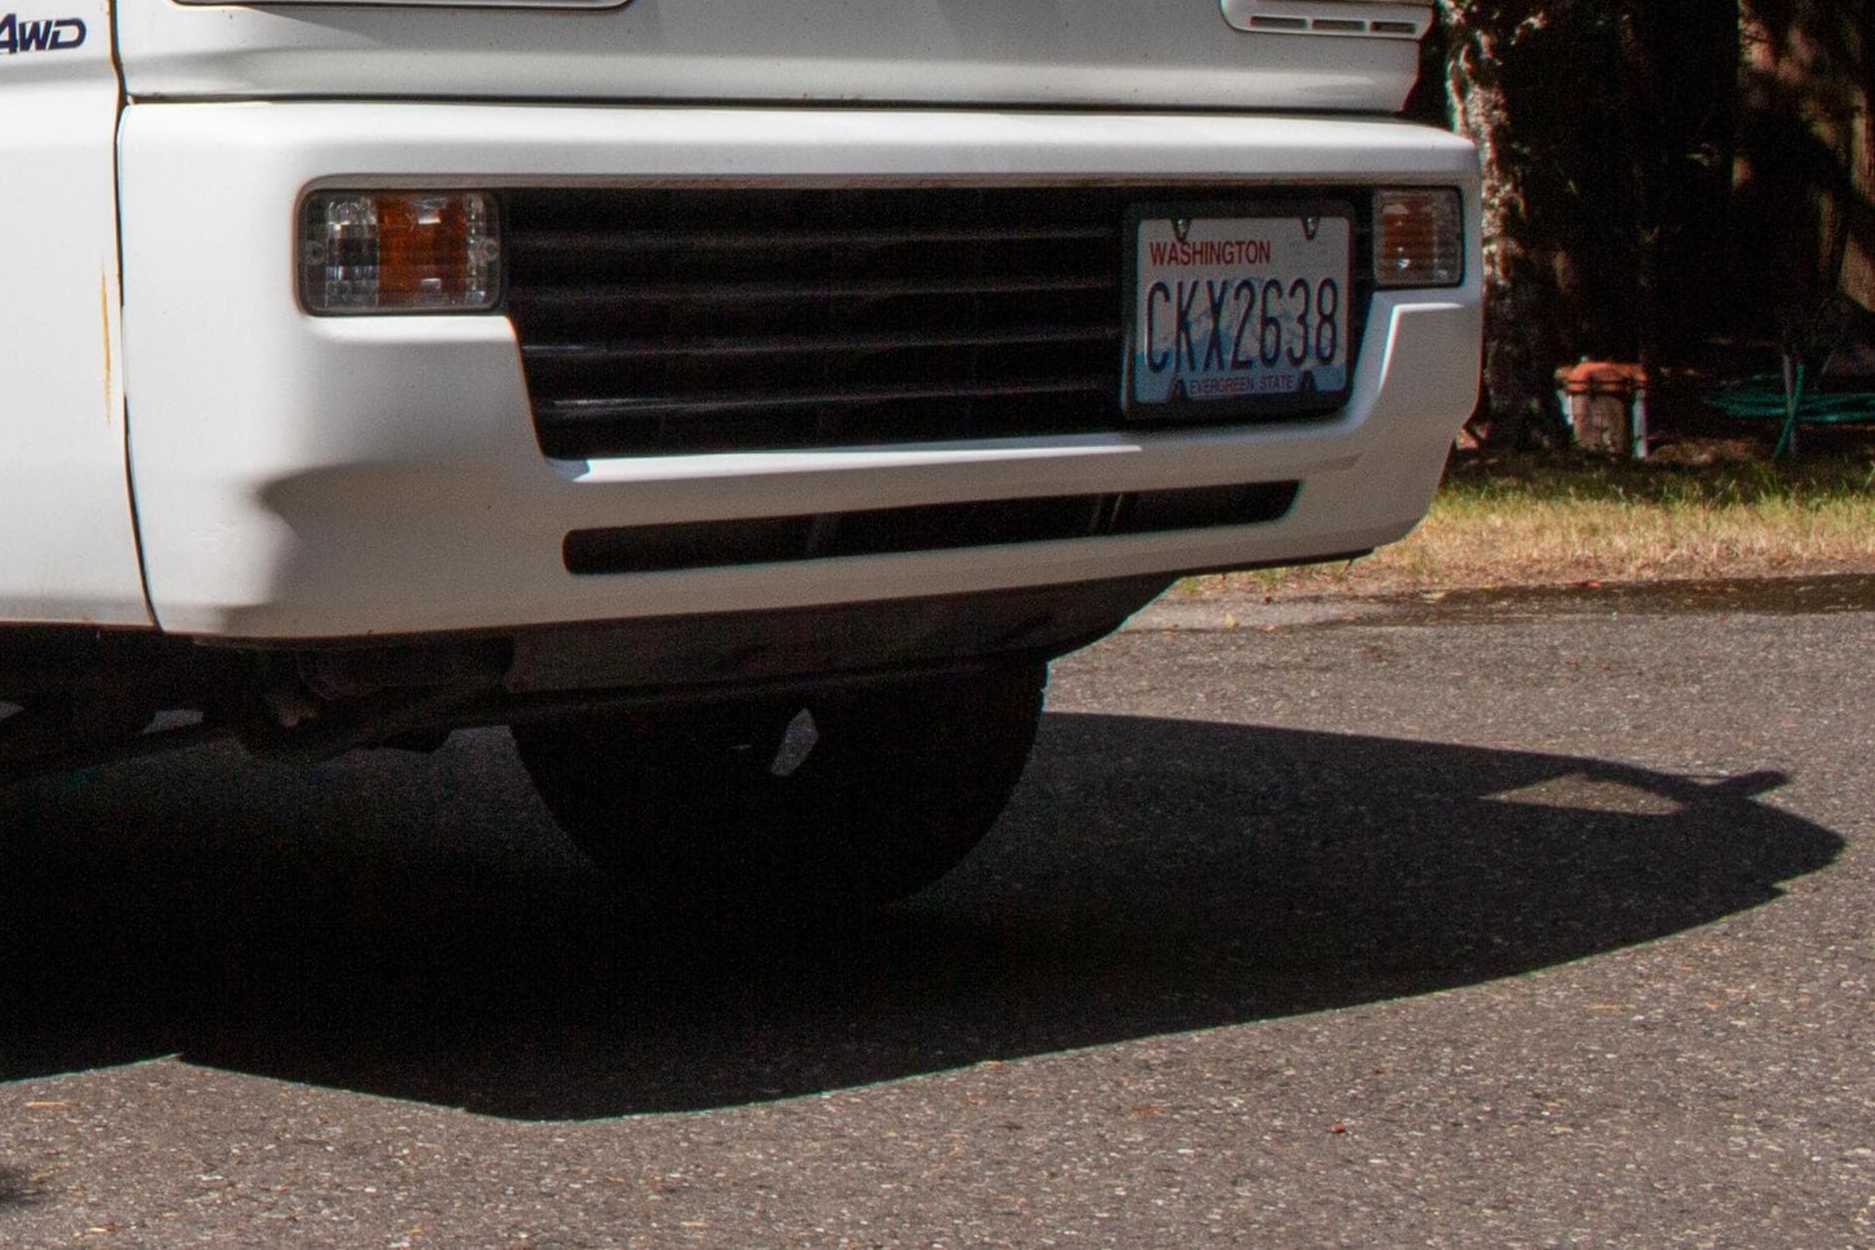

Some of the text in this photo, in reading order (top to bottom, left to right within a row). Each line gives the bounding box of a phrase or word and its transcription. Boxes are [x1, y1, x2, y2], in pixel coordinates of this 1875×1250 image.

[1149, 239, 1271, 266] WASHINGTON
[1146, 278, 1339, 374] CKX2638
[1191, 375, 1295, 395] EVERGREEN STATE
